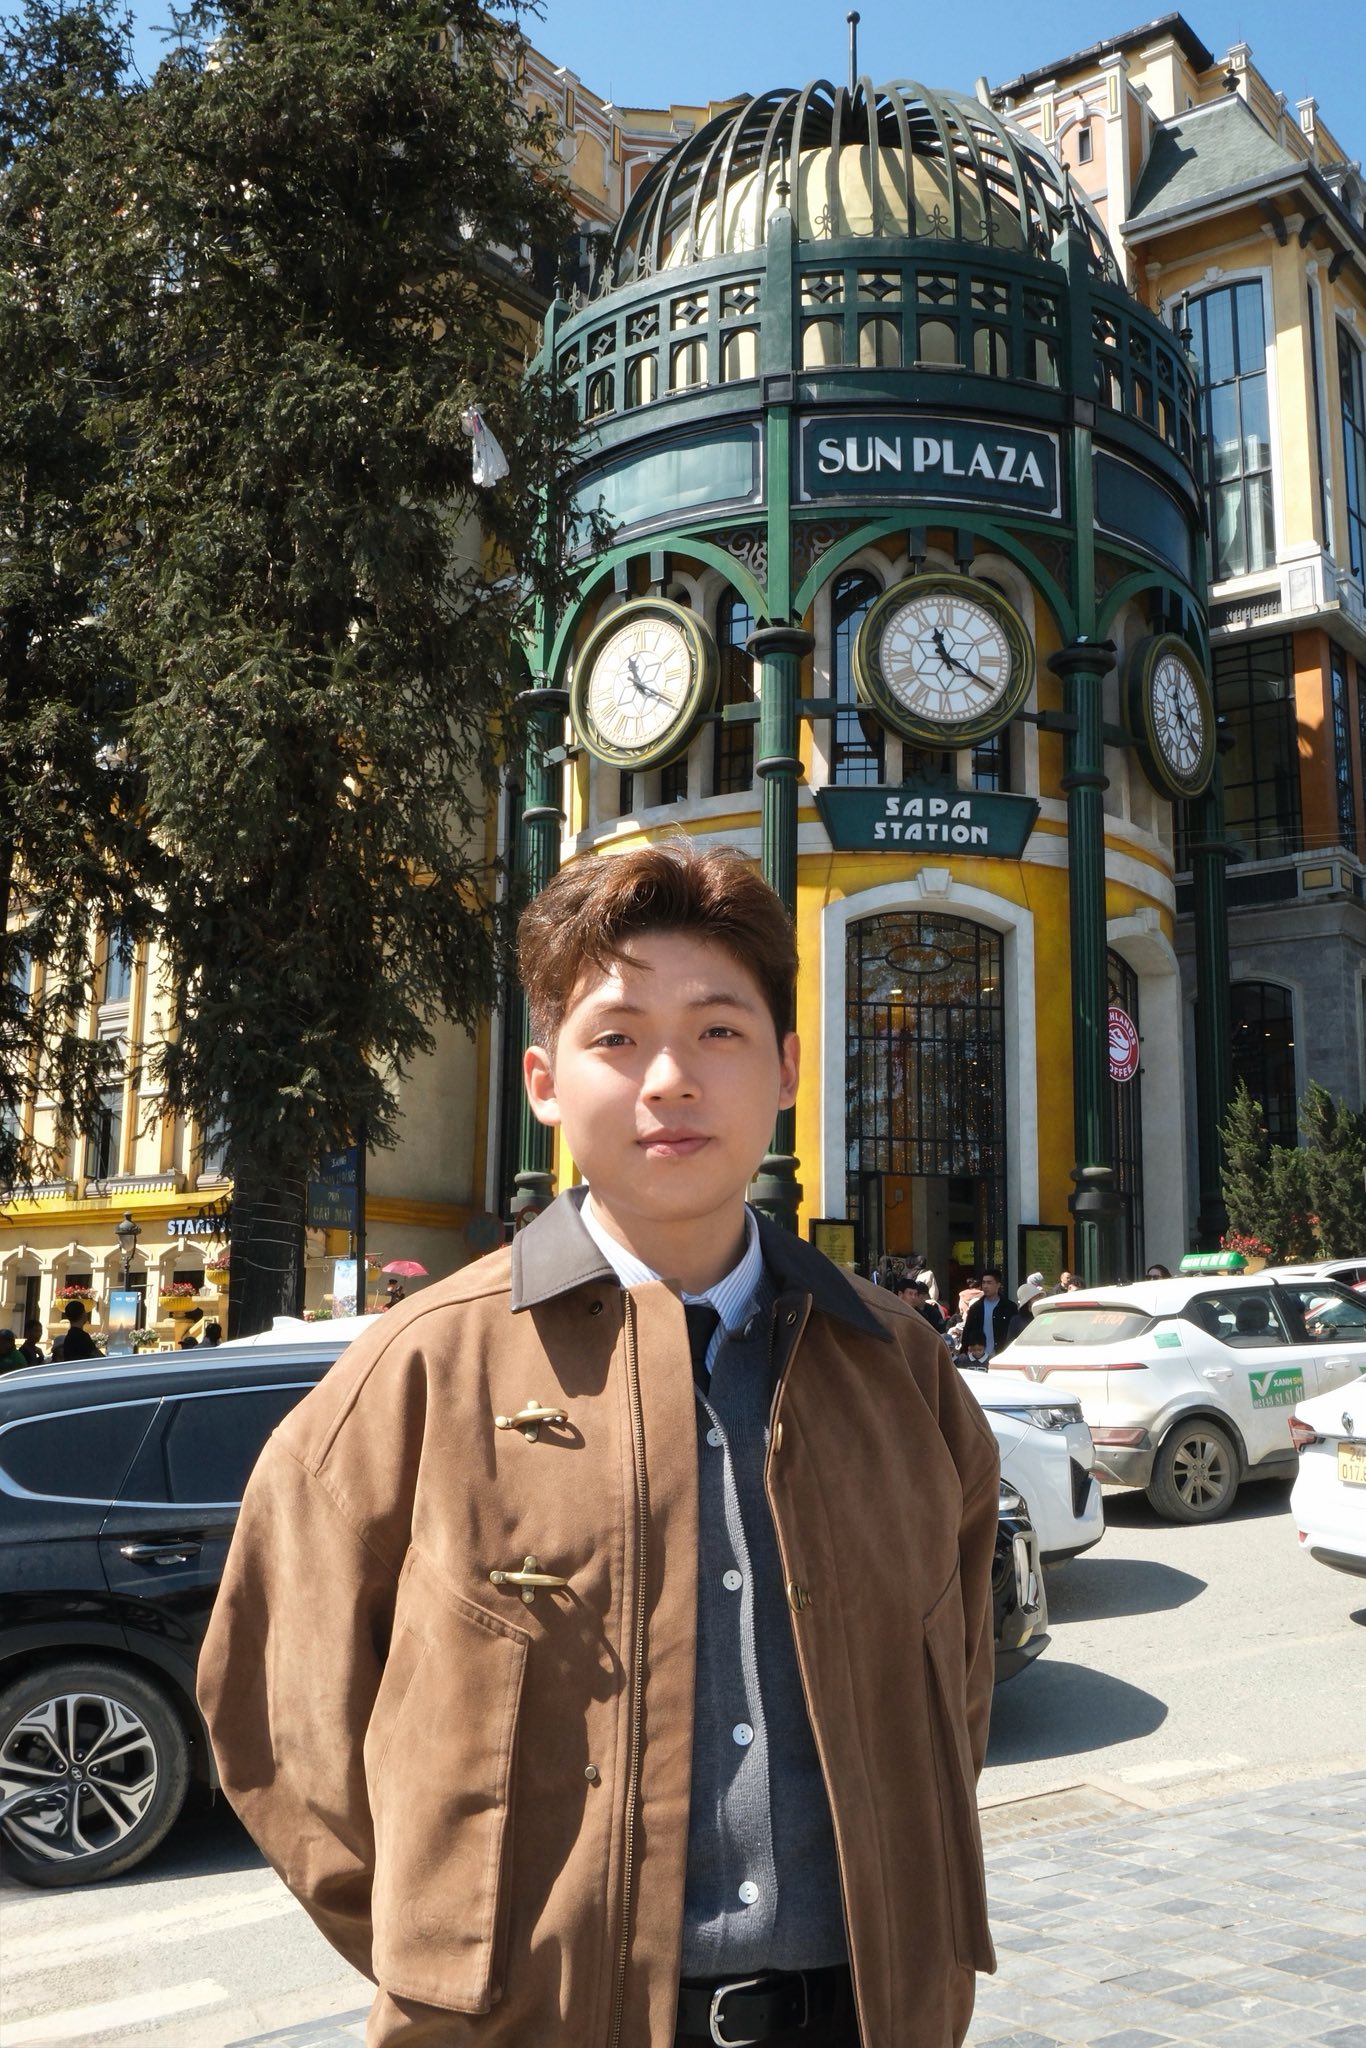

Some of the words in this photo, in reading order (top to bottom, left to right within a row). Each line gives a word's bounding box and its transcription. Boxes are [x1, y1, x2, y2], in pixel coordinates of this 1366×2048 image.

[818, 436, 902, 474] SUN
[913, 436, 1045, 487] PLAZA
[885, 796, 971, 820] SAPA
[873, 822, 988, 845] STATION
[1273, 1377, 1292, 1387] XANH
